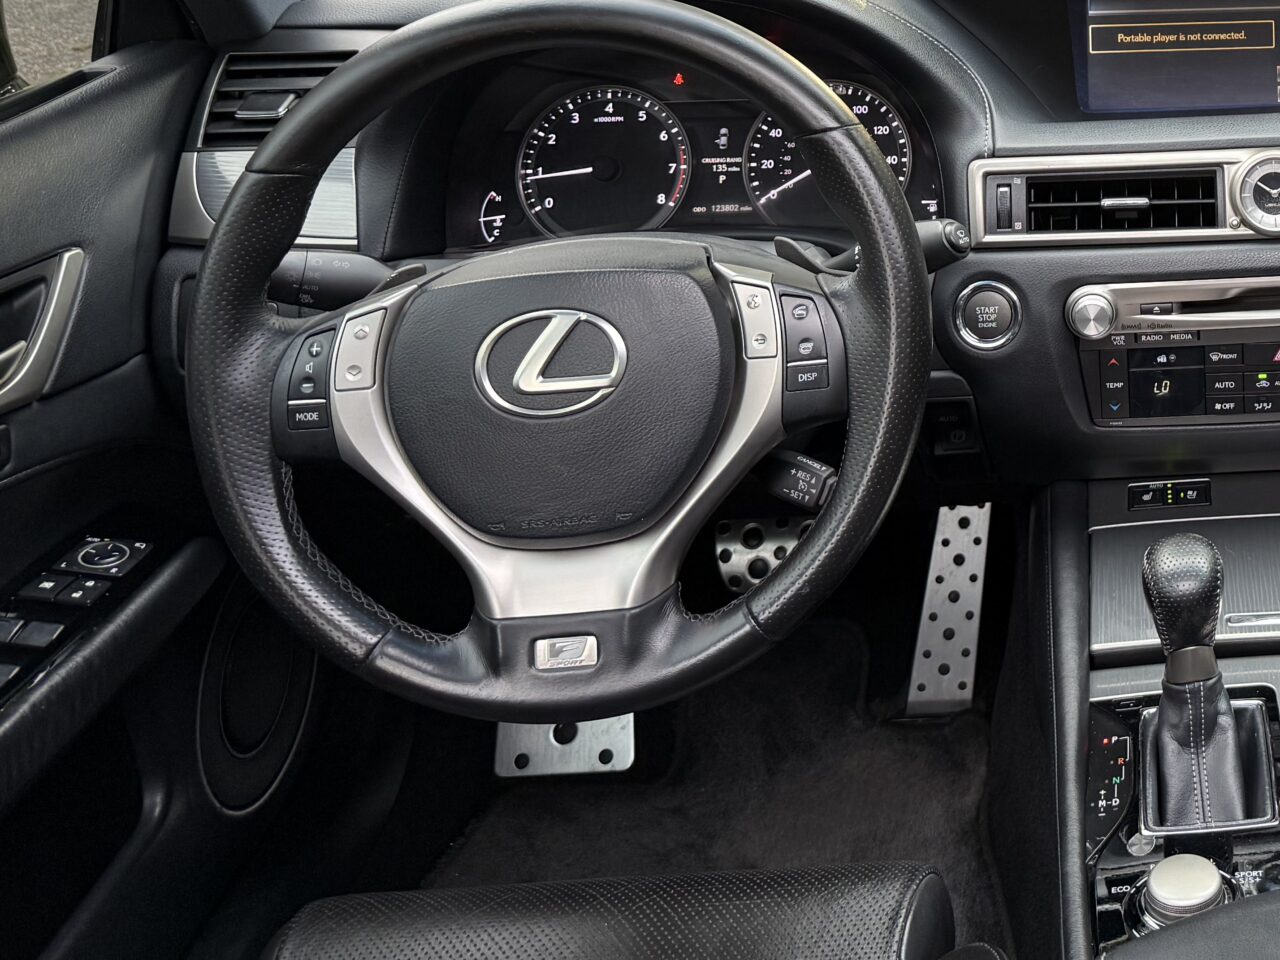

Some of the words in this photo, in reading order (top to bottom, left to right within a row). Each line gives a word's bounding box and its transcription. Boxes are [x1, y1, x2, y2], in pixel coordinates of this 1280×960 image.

[1117, 33, 1152, 43] Portable
[1153, 33, 1178, 45] player
[1179, 32, 1186, 41] is
[1187, 32, 1201, 41] not
[1202, 30, 1247, 40] connected.
[605, 102, 614, 113] 4
[852, 105, 869, 114] 100
[571, 113, 580, 124] 3
[638, 111, 647, 121] 5
[769, 128, 783, 138] 40
[873, 126, 890, 135] 120
[548, 134, 556, 145] 2
[659, 131, 668, 141] 6
[761, 160, 775, 169] 20
[886, 155, 898, 165] 40
[668, 164, 677, 174] 7
[712, 164, 727, 172] 135
[719, 175, 726, 184] P
[544, 198, 554, 208] 0
[657, 194, 666, 205] 8
[975, 306, 999, 314] START
[978, 313, 997, 321] STOP
[798, 372, 818, 382] DISP
[1154, 380, 1170, 393] LO
[1214, 381, 1235, 389] AUTO
[1222, 402, 1235, 410] OFF
[296, 412, 320, 421] MODE
[1111, 735, 1118, 744] P
[1118, 757, 1125, 765] R
[1112, 776, 1120, 784] N
[1098, 800, 1106, 808] M
[1112, 798, 1120, 806] D
[1234, 870, 1264, 878] SPORT
[1111, 885, 1131, 894] ECO
